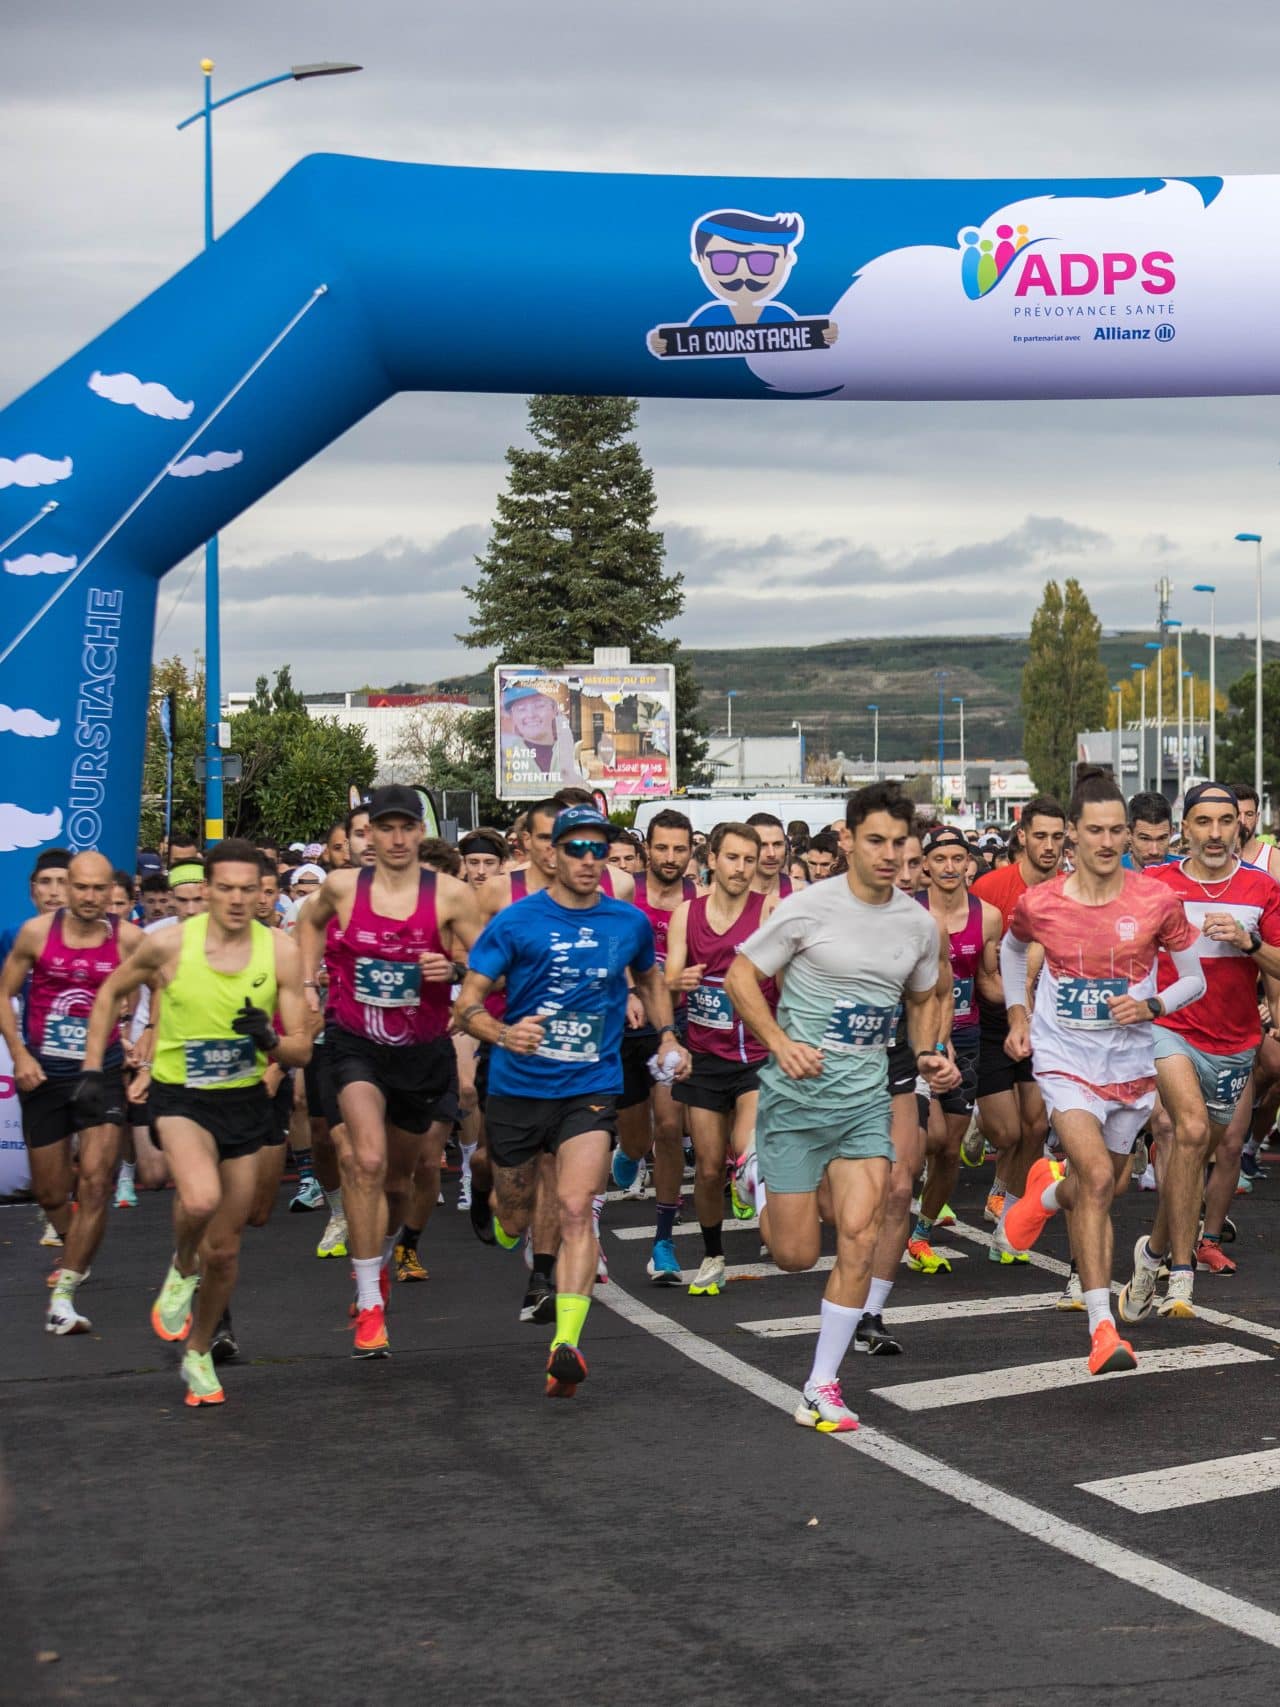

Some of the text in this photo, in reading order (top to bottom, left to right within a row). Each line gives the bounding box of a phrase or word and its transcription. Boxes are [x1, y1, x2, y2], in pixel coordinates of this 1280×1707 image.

[1014, 250, 1176, 297] ADPS
[1014, 303, 1117, 318] PRÉVOYANCE
[675, 327, 812, 353] LA COURSTACHE
[1023, 334, 1064, 344] partenariat
[1093, 326, 1151, 341] Allianz
[67, 587, 124, 855] OURSTACHE
[369, 969, 406, 985] 903
[1067, 988, 1115, 1005] 7430
[549, 1020, 592, 1038] 1530
